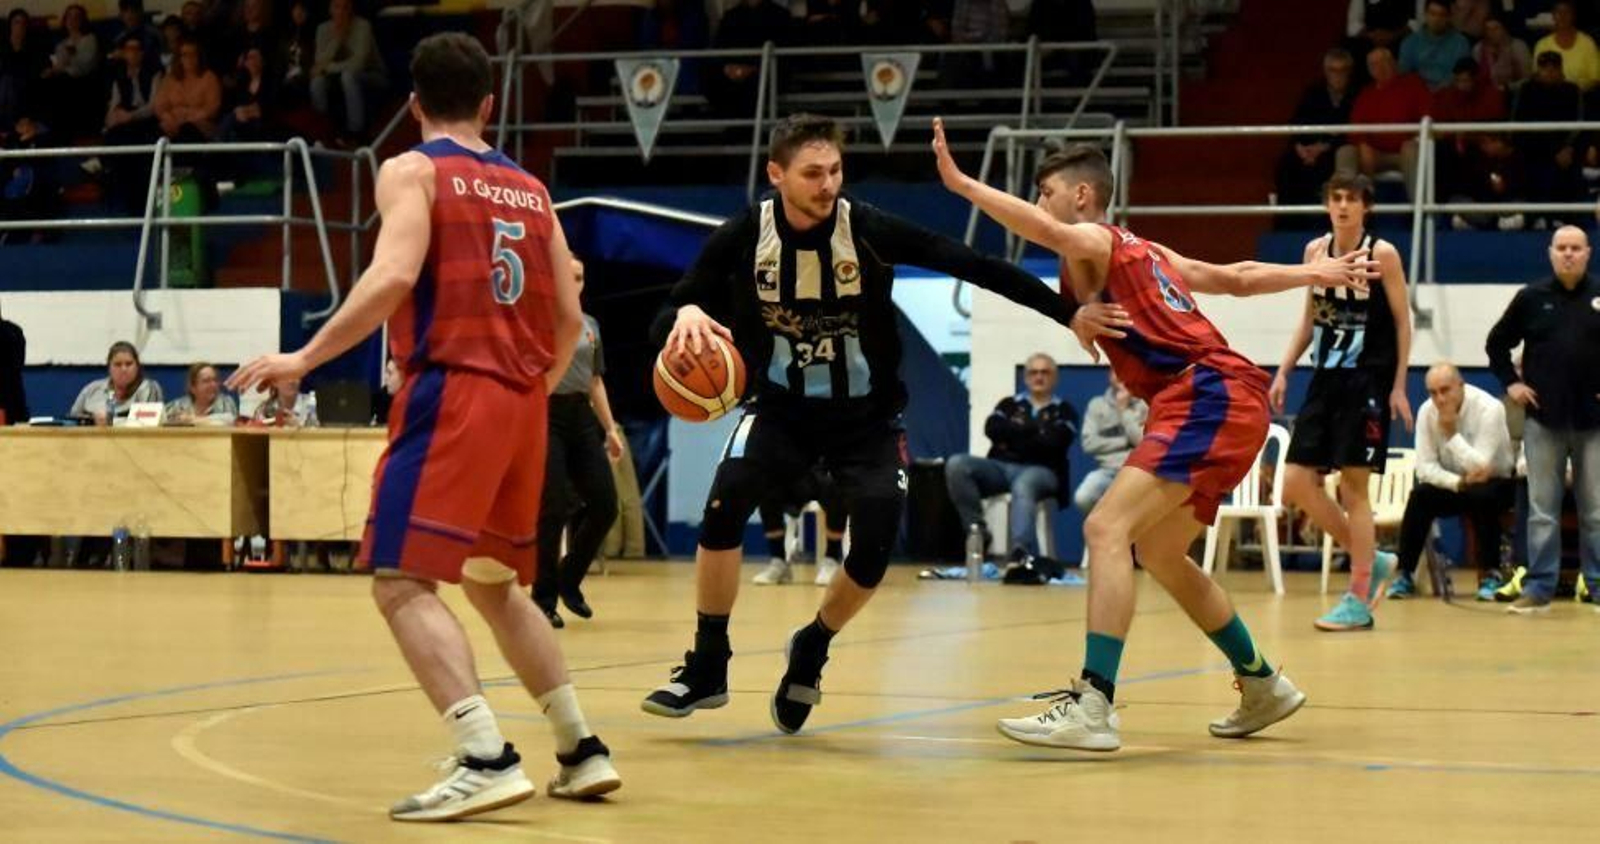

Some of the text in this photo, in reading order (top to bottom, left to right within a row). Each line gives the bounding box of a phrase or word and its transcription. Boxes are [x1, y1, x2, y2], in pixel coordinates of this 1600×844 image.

[453, 177, 471, 195] D.
[491, 217, 525, 305] 5
[1334, 328, 1346, 349] 7
[796, 337, 836, 368] 34
[1365, 447, 1376, 462] 7
